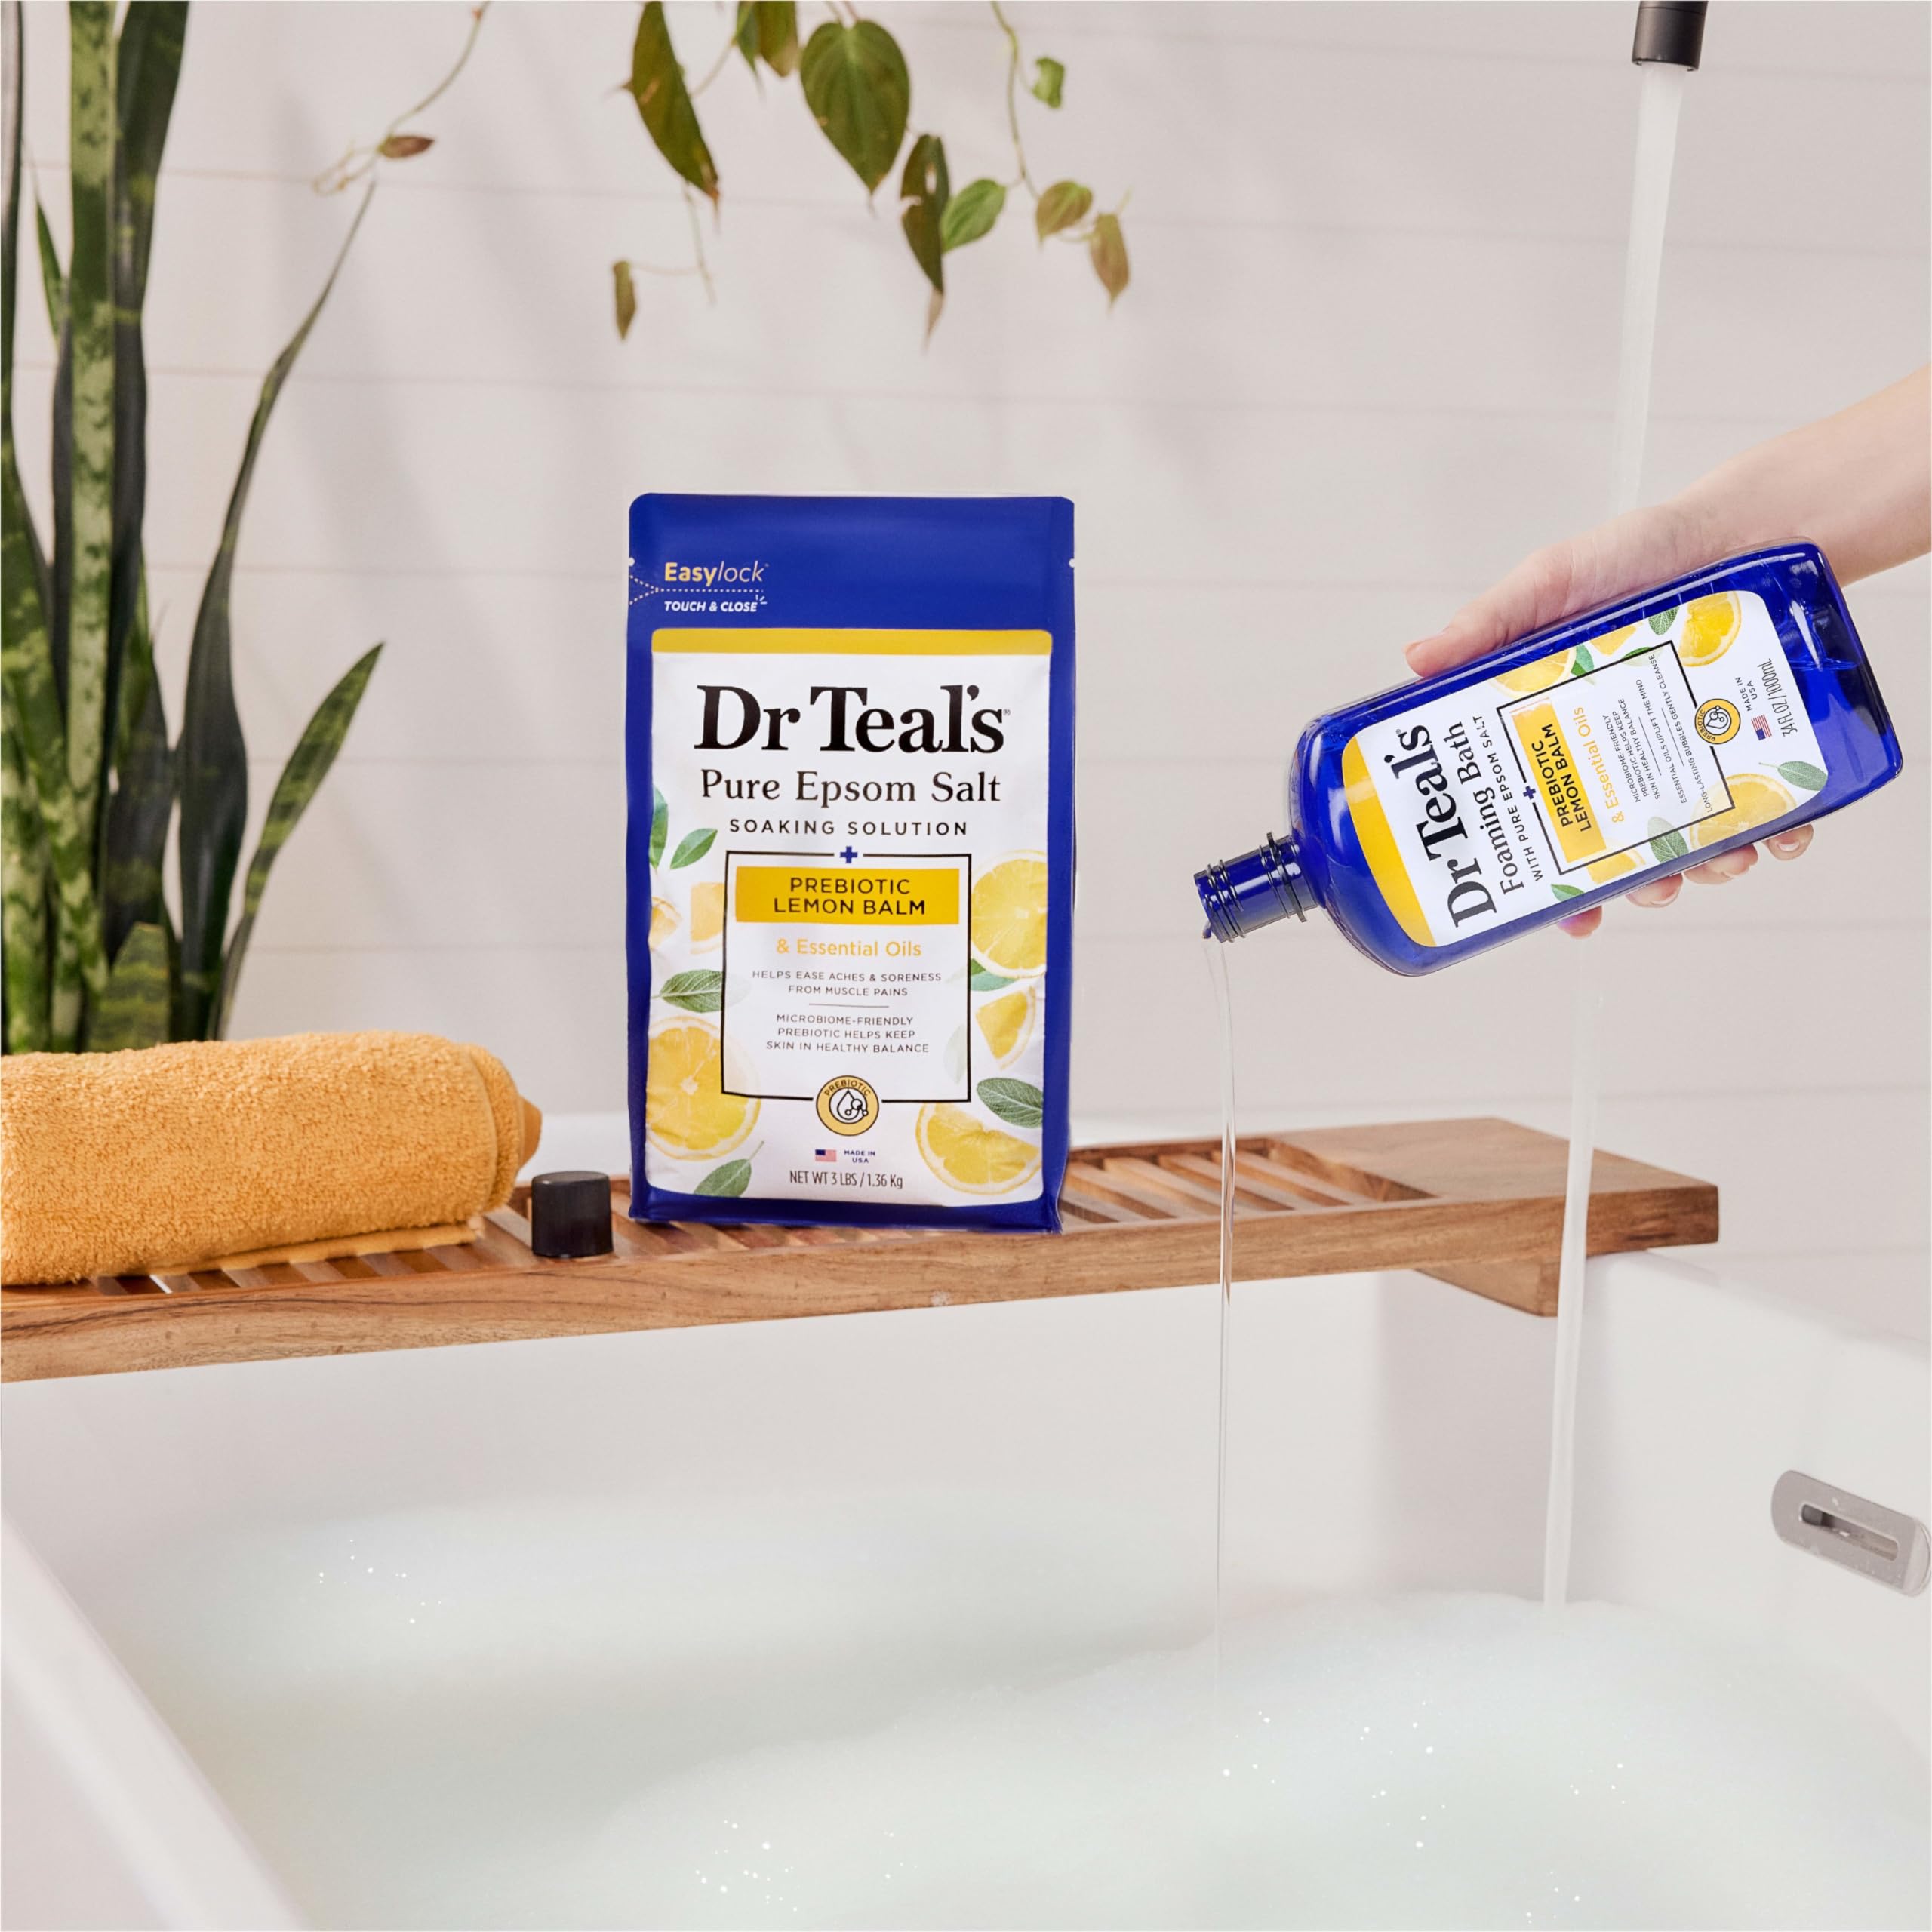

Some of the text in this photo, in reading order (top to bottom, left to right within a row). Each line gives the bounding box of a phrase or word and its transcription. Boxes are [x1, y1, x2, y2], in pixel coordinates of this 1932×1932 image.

[664, 560, 764, 587] Easylock
[664, 601, 758, 612] TOUCH & CLOSE
[1746, 680, 1757, 700] USA
[1757, 657, 1782, 696] 1000mL
[1735, 677, 1752, 711] MADE IN
[1771, 699, 1789, 713] OZ
[694, 685, 800, 750] Dr
[1697, 709, 1715, 741] PREBIOTIC
[1777, 711, 1793, 724] FL
[1780, 722, 1798, 737] 34
[1635, 679, 1687, 803] ESSENTIAL OILS UPLIFT THE MIND
[1647, 654, 1712, 812] LONG-LASTING BUBBLES GENTLY CLEANSE
[1602, 715, 1641, 802] MICROBIOME-FRIENDLY
[1612, 711, 1649, 797] PREBIOTIC HELPS KEEP
[1617, 698, 1660, 799] SKIN IN HEALTHY BALANCE
[1541, 724, 1591, 831] LEMON BALM
[1573, 707, 1624, 823] & Essential Oils
[702, 769, 1000, 808] Pure Epsom Salt
[1531, 740, 1573, 826] PREBIOTIC
[1443, 721, 1524, 894] Foaming Bath
[1472, 716, 1543, 881] WITH PURE EPSOM SALT
[730, 818, 967, 836] SOAKING SOLUTION
[790, 877, 910, 895] PREBIOTIC
[1447, 857, 1497, 928] Dr
[774, 897, 925, 915] LEMON BALM
[776, 937, 922, 958] & Essential Oils
[752, 970, 941, 983] HELPS EASE ACHES & SORENESS
[788, 985, 908, 997] FROM MUSCLE PAINS
[776, 1014, 913, 1026] MICROBIOME-FRIENDLY
[777, 1027, 915, 1039] PREBIOTIC HELPS KEEP
[766, 1041, 928, 1054] SKIN IN HEALTHY BALANCE
[824, 1079, 871, 1096] PREBIOTIC
[789, 1171, 903, 1190] NET WT 3 LBS / 1.36 Kg
